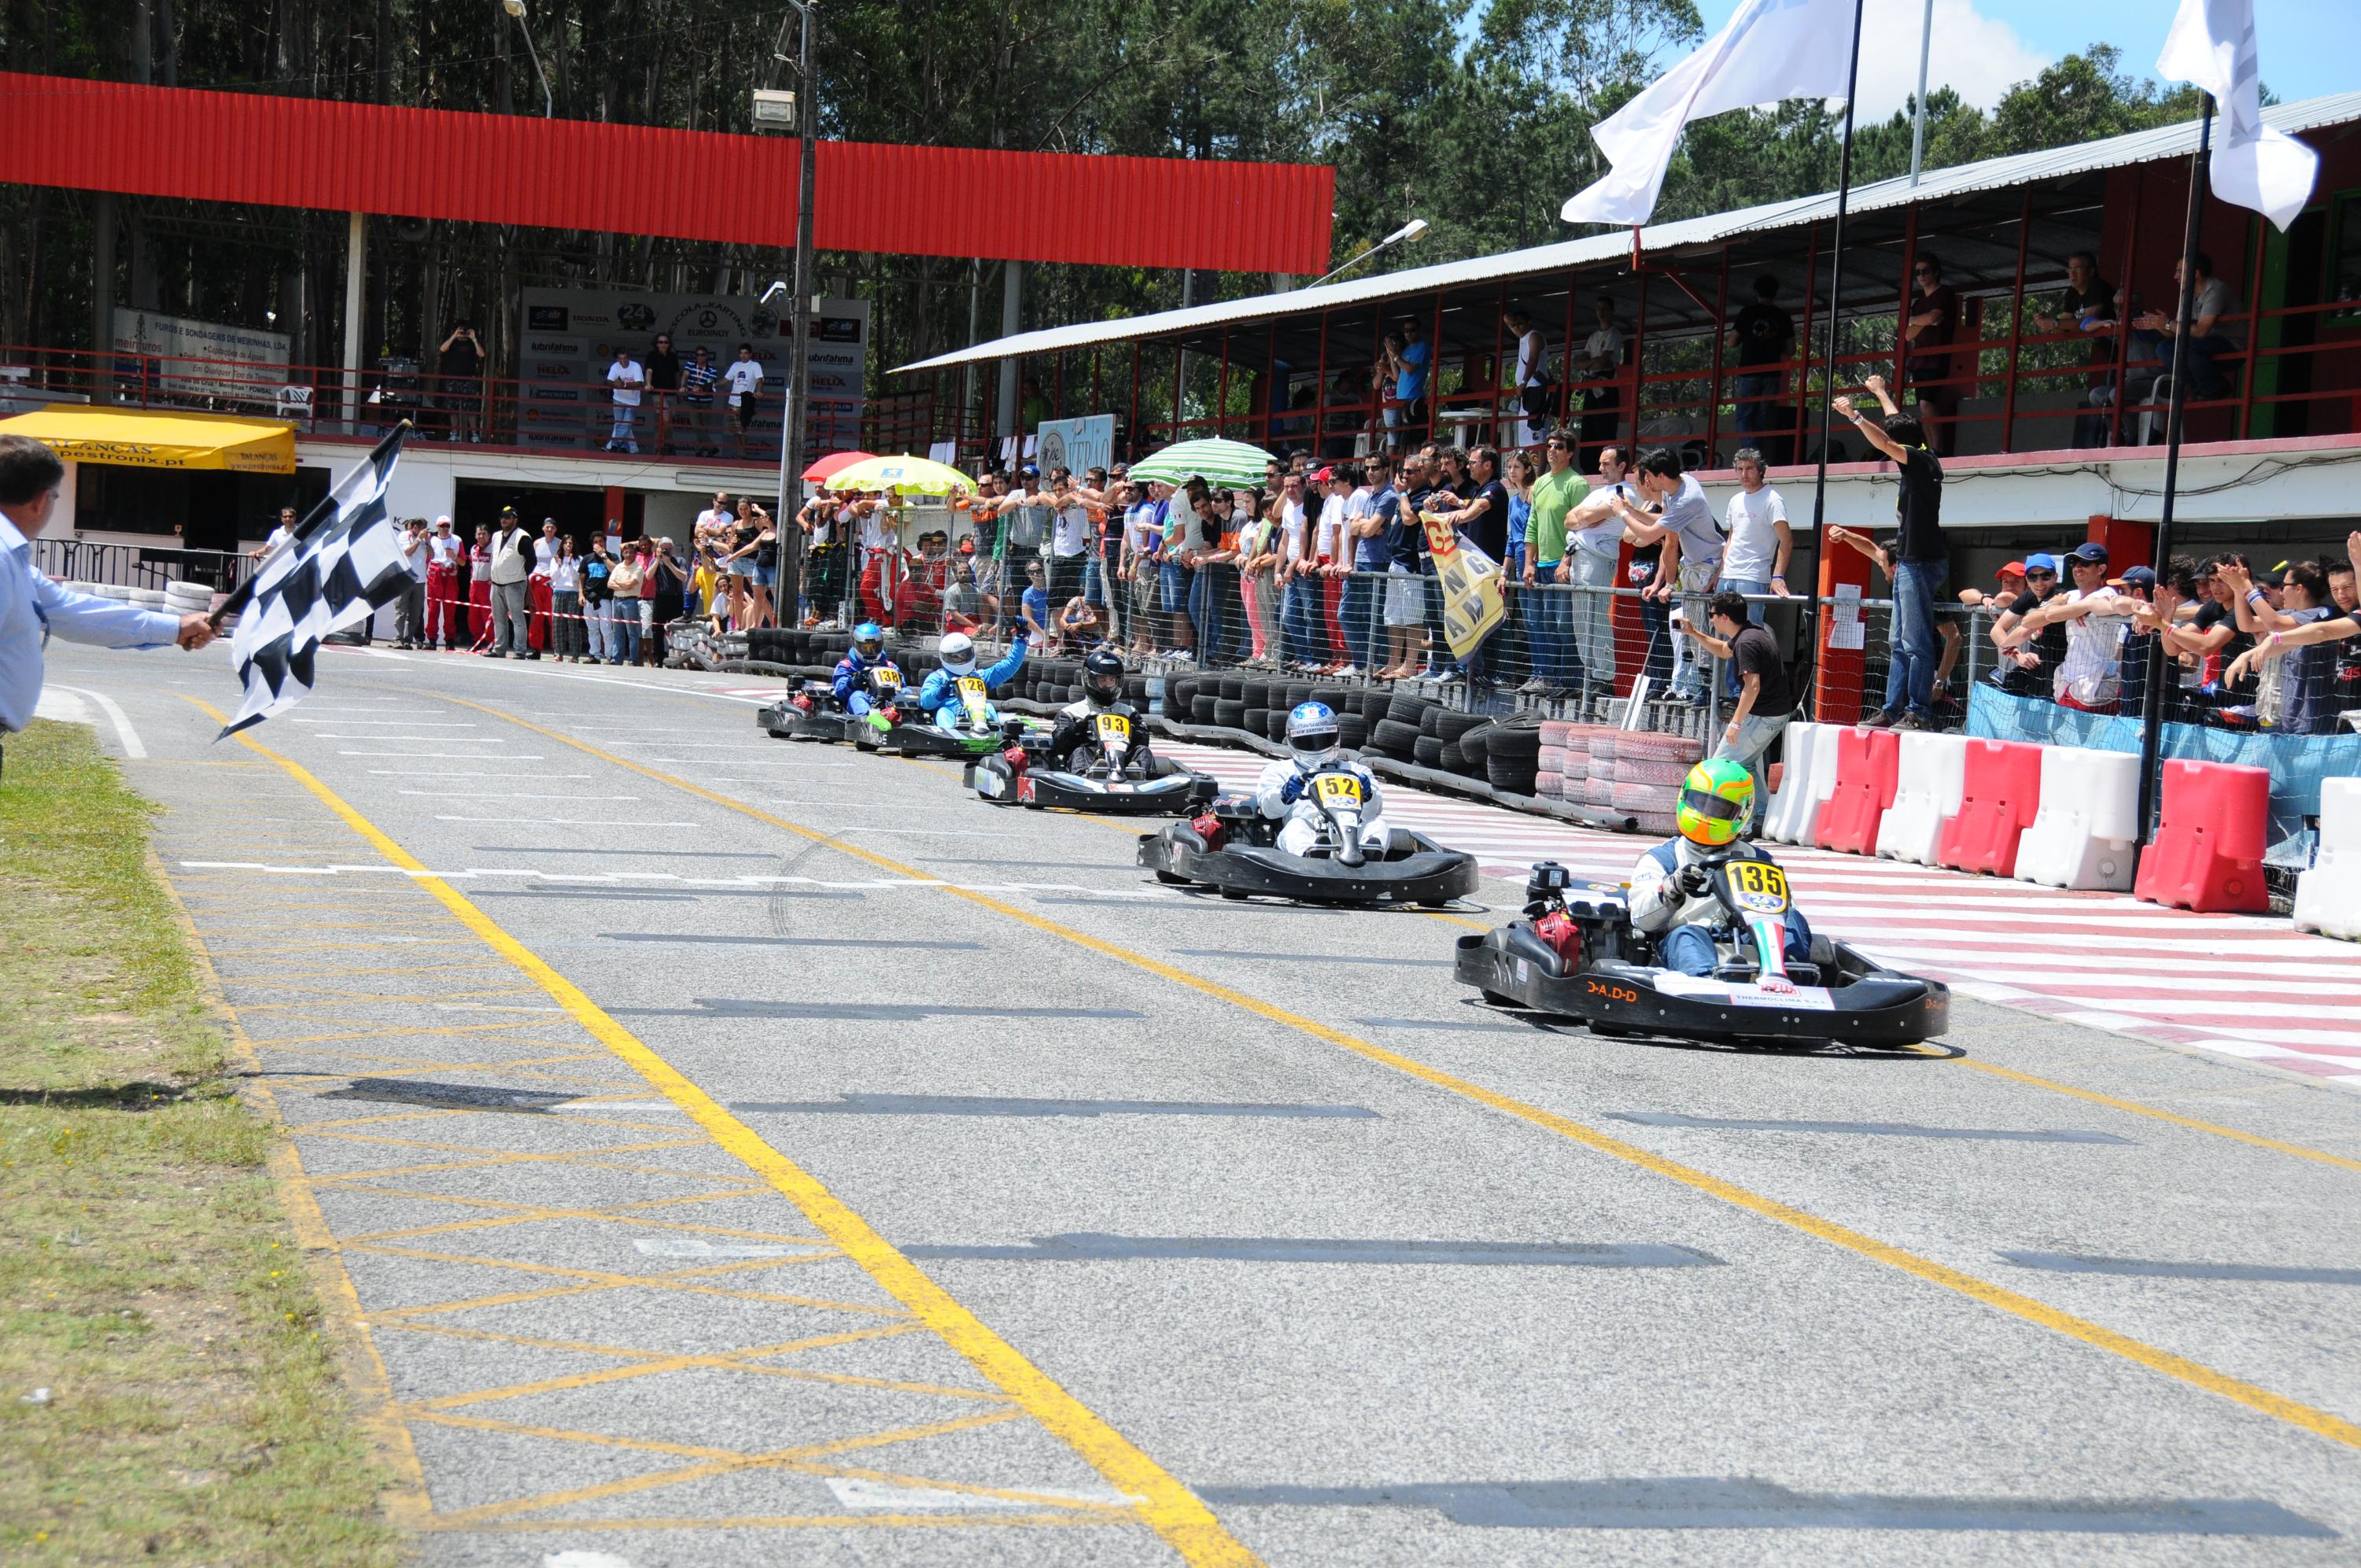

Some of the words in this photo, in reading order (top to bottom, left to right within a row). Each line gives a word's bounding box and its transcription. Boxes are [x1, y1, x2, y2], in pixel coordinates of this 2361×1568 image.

[669, 302, 703, 335] ESCOLA
[708, 302, 747, 338] KARTING
[154, 321, 178, 334] FUROS
[179, 327, 185, 335] E
[185, 328, 226, 341] SONDAGENS
[227, 334, 236, 344] DE
[688, 329, 729, 338] EUROINDY
[205, 366, 231, 376] Qualquer
[537, 365, 570, 375] HELIX
[811, 377, 846, 386] HELIX
[249, 386, 273, 395] POMBAL
[50, 441, 153, 456] ALANÇAS
[877, 670, 899, 684] 138
[961, 679, 984, 692] 128
[1101, 717, 1124, 732] 93
[1325, 777, 1356, 795] 52
[1731, 865, 1782, 896] 135
